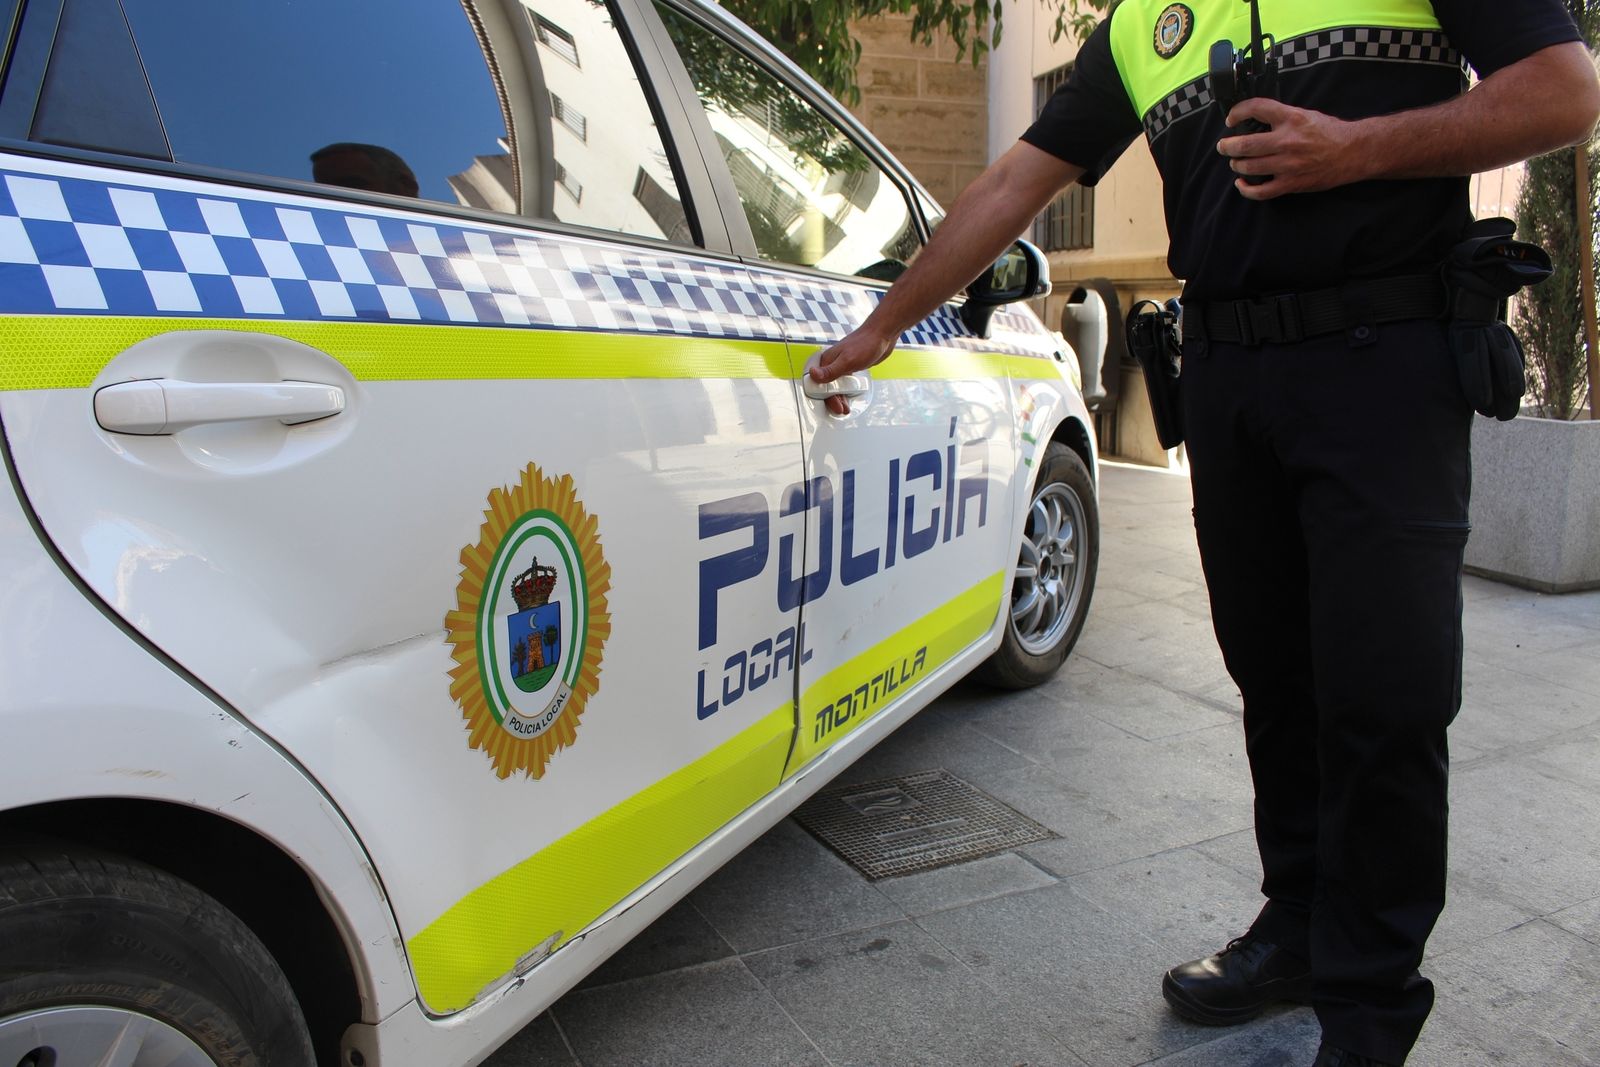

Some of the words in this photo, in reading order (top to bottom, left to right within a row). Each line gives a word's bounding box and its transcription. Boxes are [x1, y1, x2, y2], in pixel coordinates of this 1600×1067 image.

[698, 416, 989, 650] POLICÍA
[509, 717, 541, 734] POLICIA
[542, 692, 567, 727] LOCAL
[696, 622, 813, 720] LOCAL
[814, 646, 927, 743] MONTILLA
